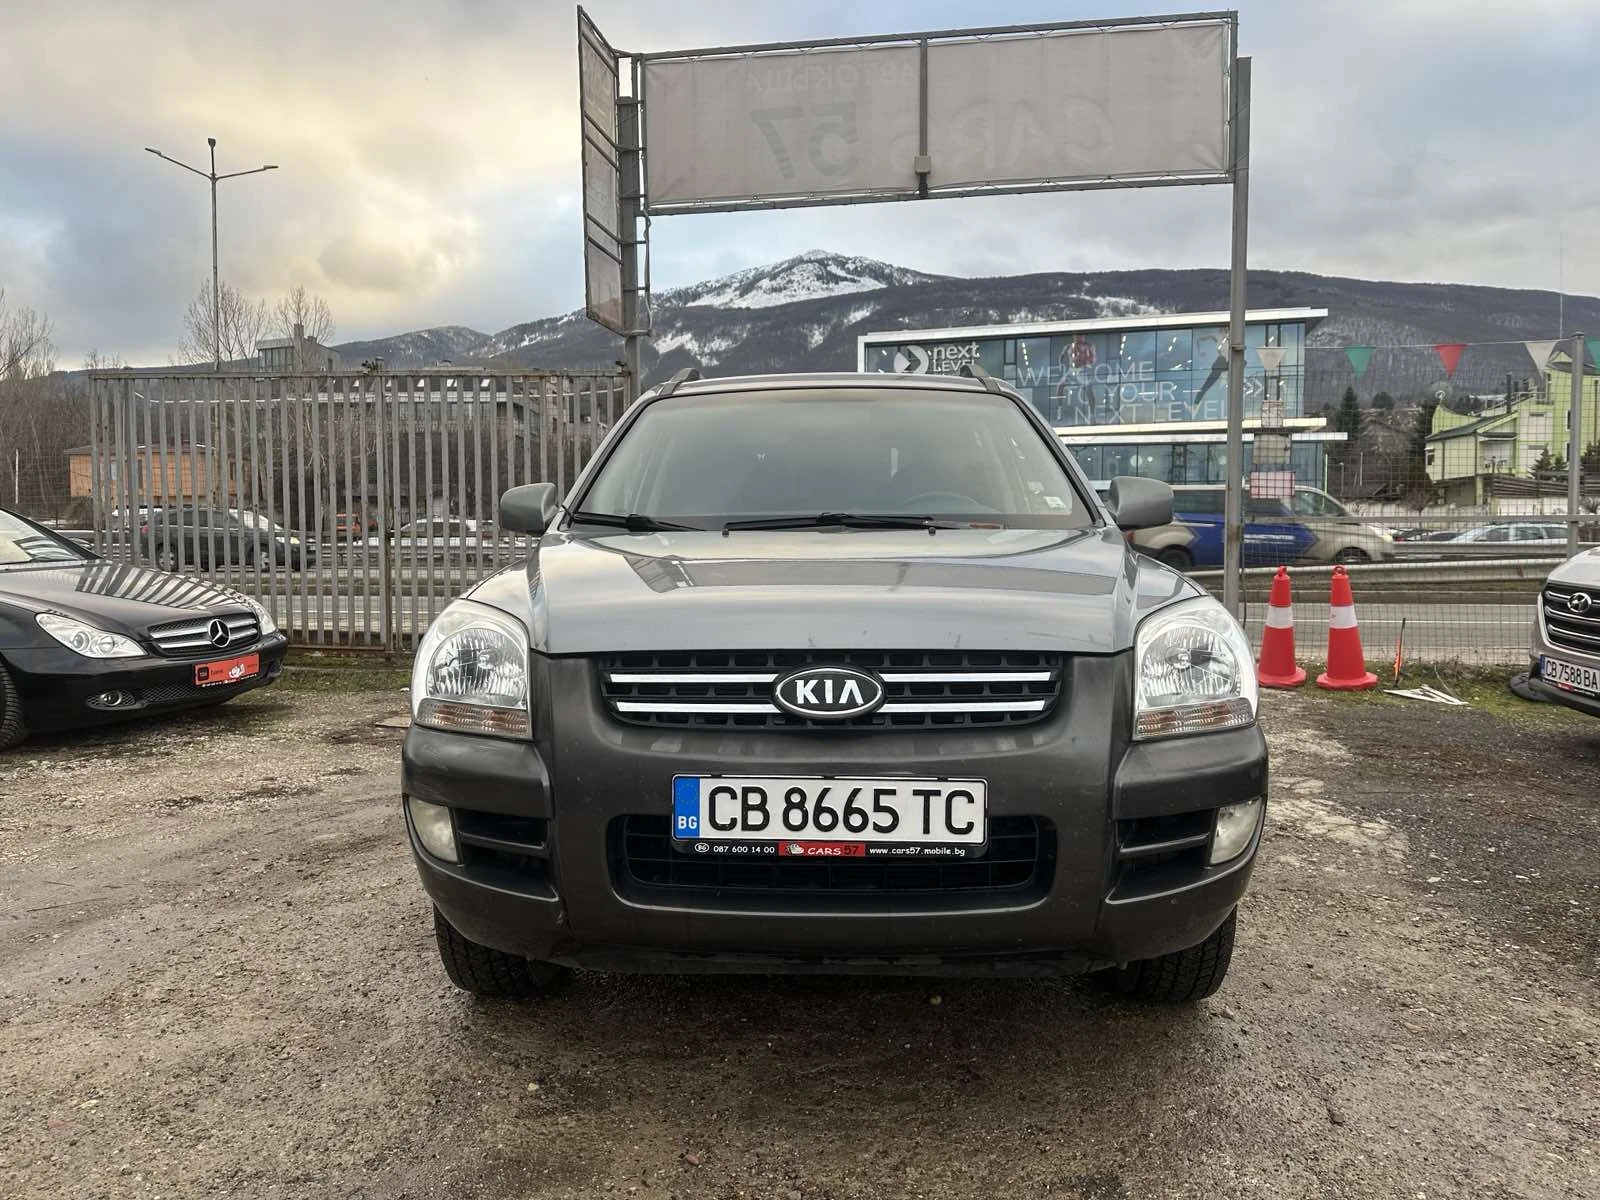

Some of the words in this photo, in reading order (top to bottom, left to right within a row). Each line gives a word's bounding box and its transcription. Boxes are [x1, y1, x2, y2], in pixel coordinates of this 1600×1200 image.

[933, 341, 980, 359] next
[1105, 381, 1176, 402] YOUR
[1074, 403, 1143, 425] NEXT
[1546, 660, 1558, 677] CB
[1559, 663, 1582, 685] 7588
[1583, 669, 1598, 690] BA
[795, 679, 865, 705] KIA
[708, 785, 771, 832] CB
[782, 786, 900, 834] 8665
[912, 788, 976, 836] TC
[678, 816, 698, 829] BG
[807, 847, 842, 855] CARS
[843, 845, 860, 855] 57
[869, 846, 966, 857] www.cars57.mobile.bg
